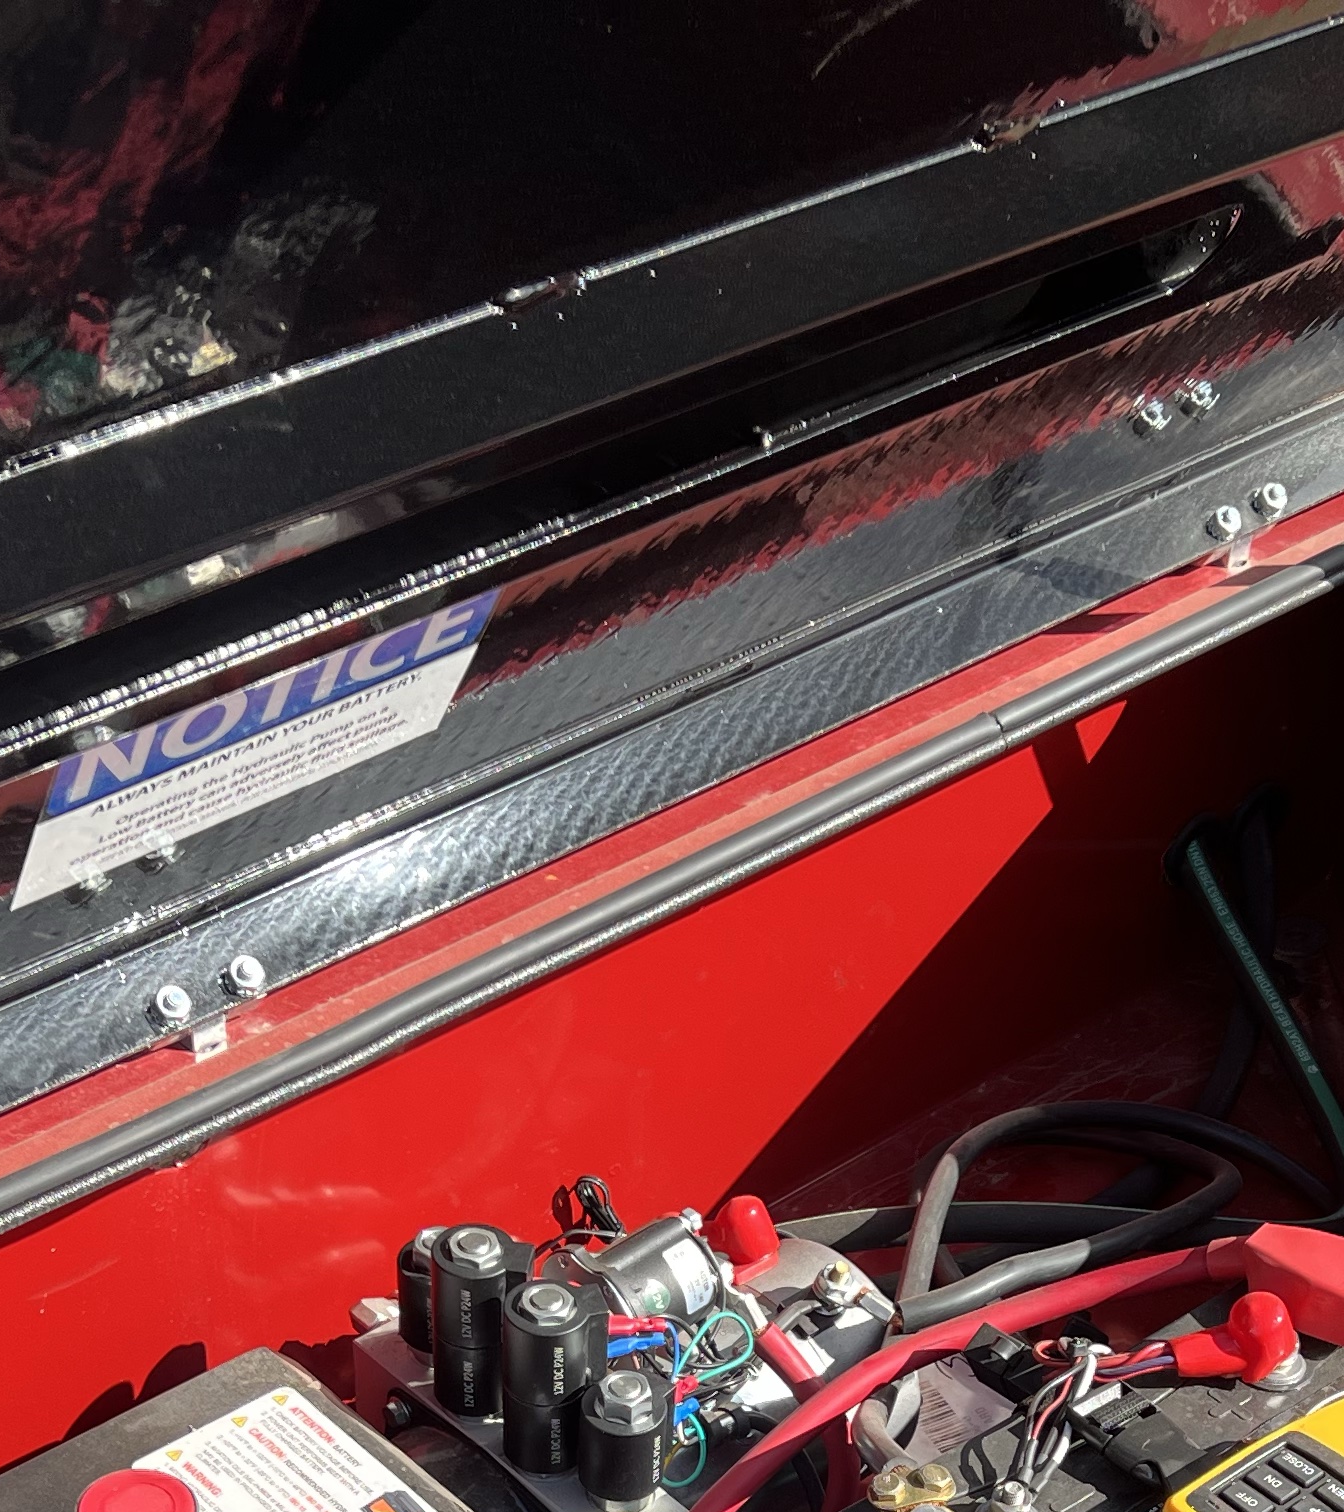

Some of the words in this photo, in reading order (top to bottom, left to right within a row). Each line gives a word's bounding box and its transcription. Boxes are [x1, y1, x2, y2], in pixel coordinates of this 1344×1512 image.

[68, 607, 474, 802] NOTICE
[89, 773, 175, 818] ALWAYS
[175, 729, 280, 782] MAINTAIN
[278, 706, 335, 740] YOUR
[336, 669, 425, 715] BATTERY.
[96, 823, 131, 847] Low
[133, 795, 196, 832] Battery
[197, 785, 225, 803] can
[227, 748, 307, 791] adversely
[307, 728, 353, 756] affect
[351, 712, 398, 739] pump
[112, 783, 200, 830] Operating
[200, 770, 230, 791] the
[230, 737, 307, 779] Hydraulic
[308, 717, 355, 746] Pump
[356, 710, 377, 725] on
[186, 791, 234, 818] cause
[234, 758, 308, 798] hydraulic
[1224, 919, 1247, 949] HOSE
[1240, 946, 1277, 1002] HYDRAULIC
[460, 1312, 472, 1323] DC
[460, 1324, 472, 1338] 12V
[553, 1368, 564, 1380] DC
[463, 1382, 474, 1393] DC
[553, 1381, 564, 1395] 12V
[463, 1394, 474, 1407] 12V
[288, 1405, 337, 1445] ATTENTION:
[331, 1443, 361, 1468] BATTERY
[551, 1438, 561, 1450] DC
[247, 1427, 288, 1460] CAUTION:
[282, 1458, 331, 1499] RECOMMENDED
[551, 1451, 561, 1464] 12V
[1282, 1452, 1315, 1475] CLOSE
[179, 1461, 225, 1497] WARNING:
[1263, 1474, 1283, 1488] DN
[1235, 1492, 1258, 1507] OFF
